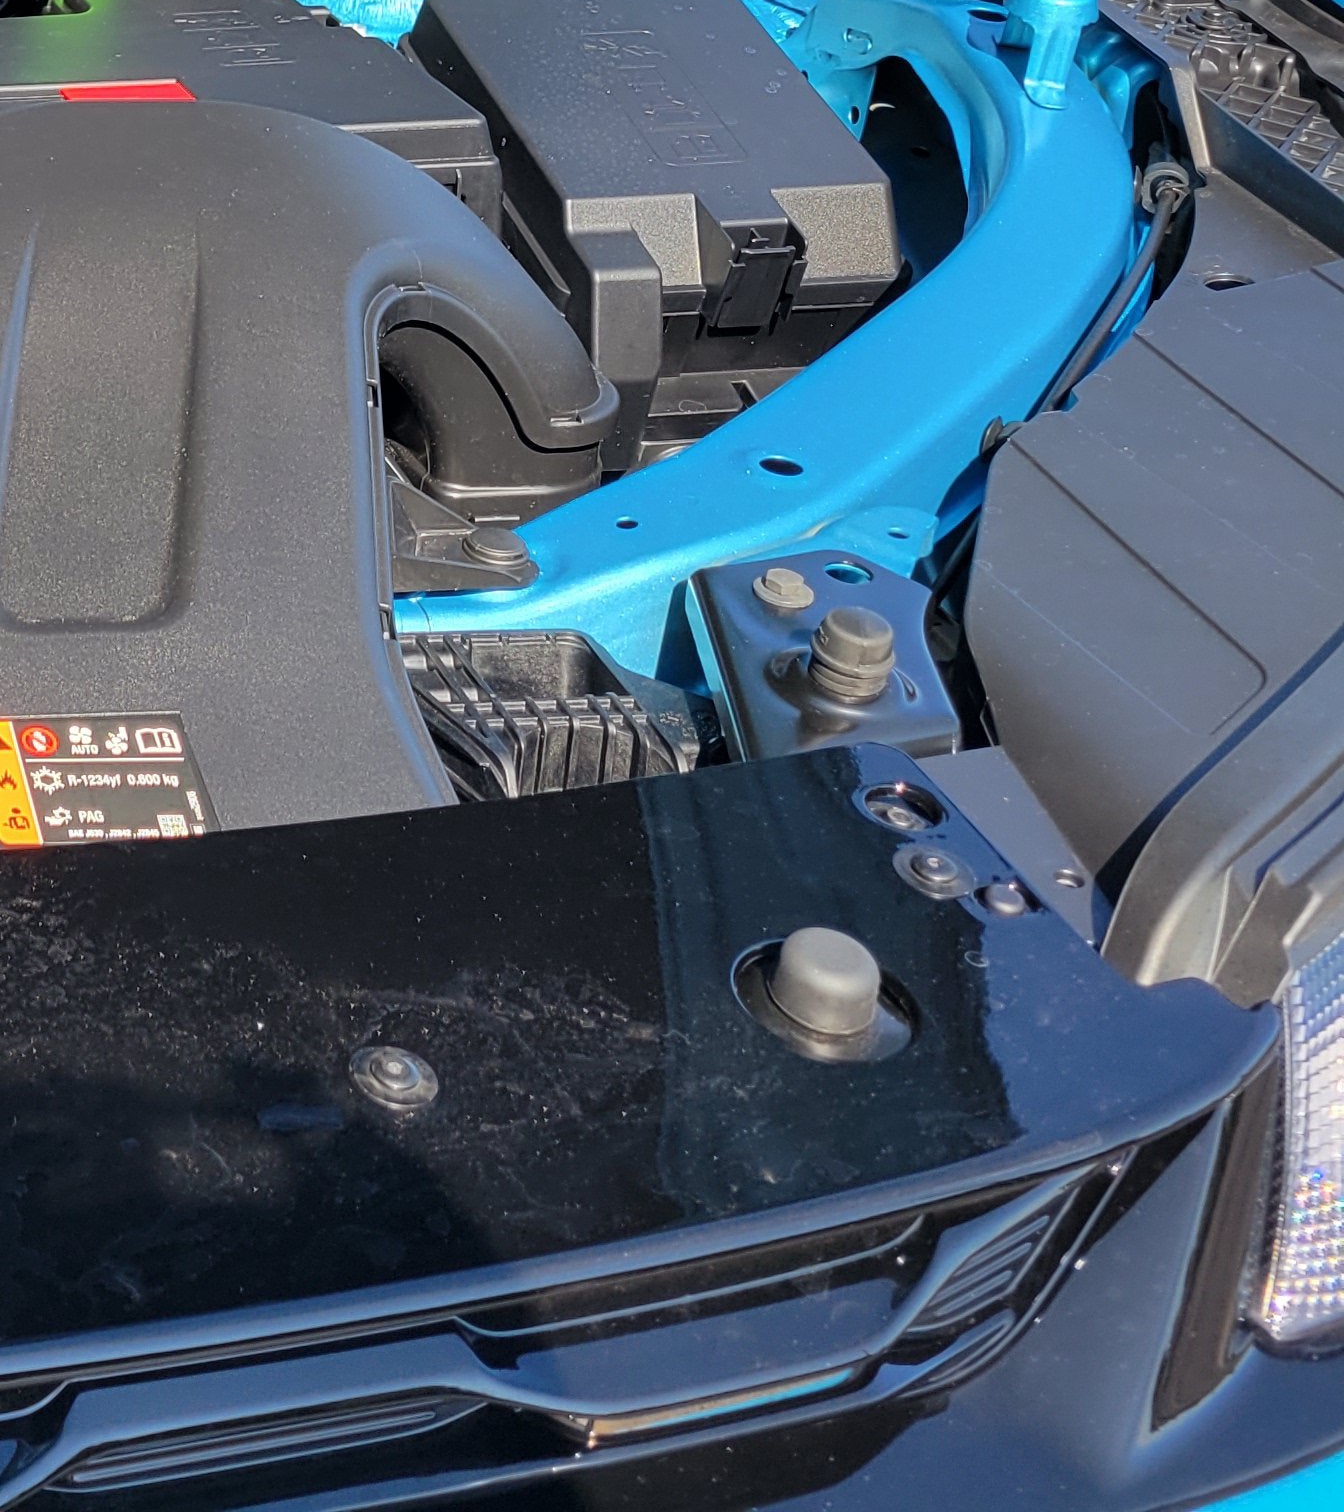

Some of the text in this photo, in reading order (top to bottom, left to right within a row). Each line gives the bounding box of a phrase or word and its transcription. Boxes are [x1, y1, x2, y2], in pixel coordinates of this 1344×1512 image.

[71, 744, 99, 755] AUTO
[67, 774, 121, 788] R-1234yf
[163, 774, 179, 788] kg
[78, 810, 104, 824] PAG
